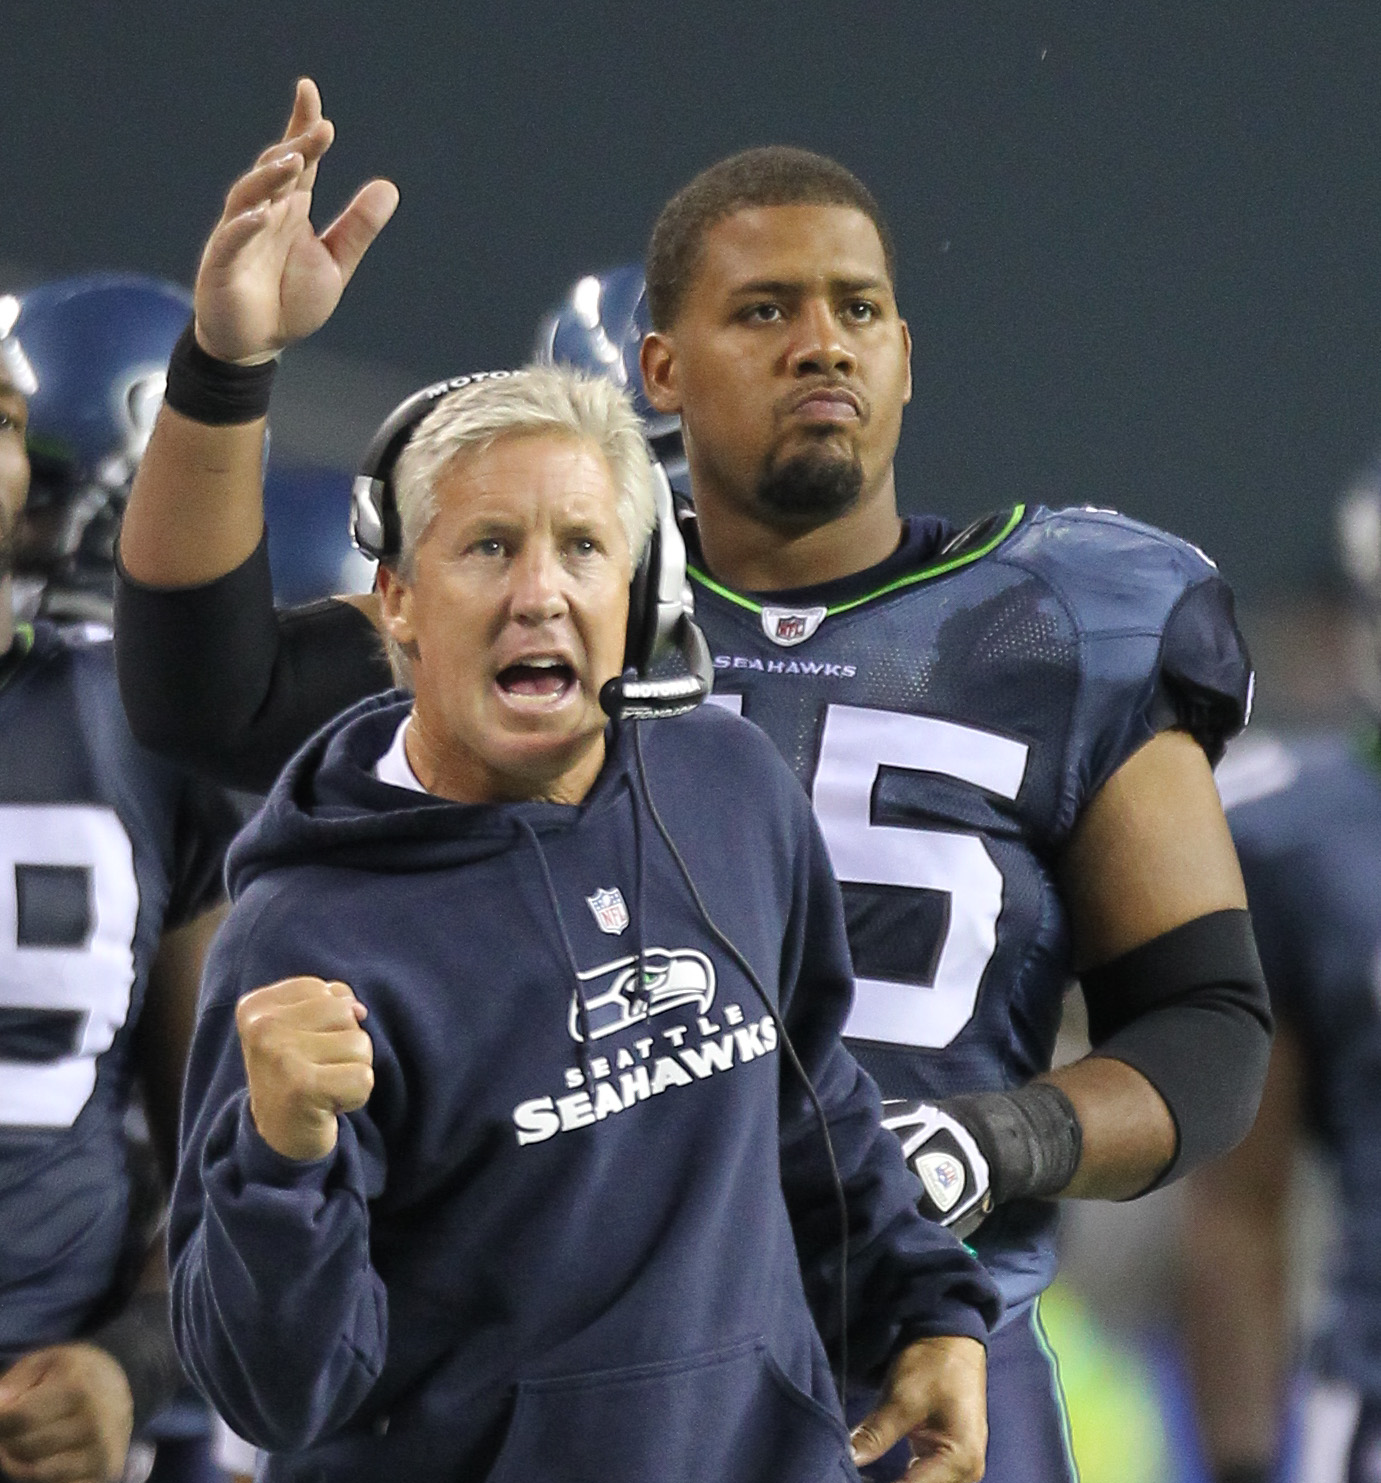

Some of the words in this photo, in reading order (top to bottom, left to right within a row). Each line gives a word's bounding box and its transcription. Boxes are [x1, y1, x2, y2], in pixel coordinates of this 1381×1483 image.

[713, 654, 857, 678] SEAHAWKS
[704, 692, 1029, 1050] 5
[600, 904, 627, 927] NFL
[513, 1015, 779, 1147] SEAHAWKS
[564, 1003, 746, 1090] SEATTLE
